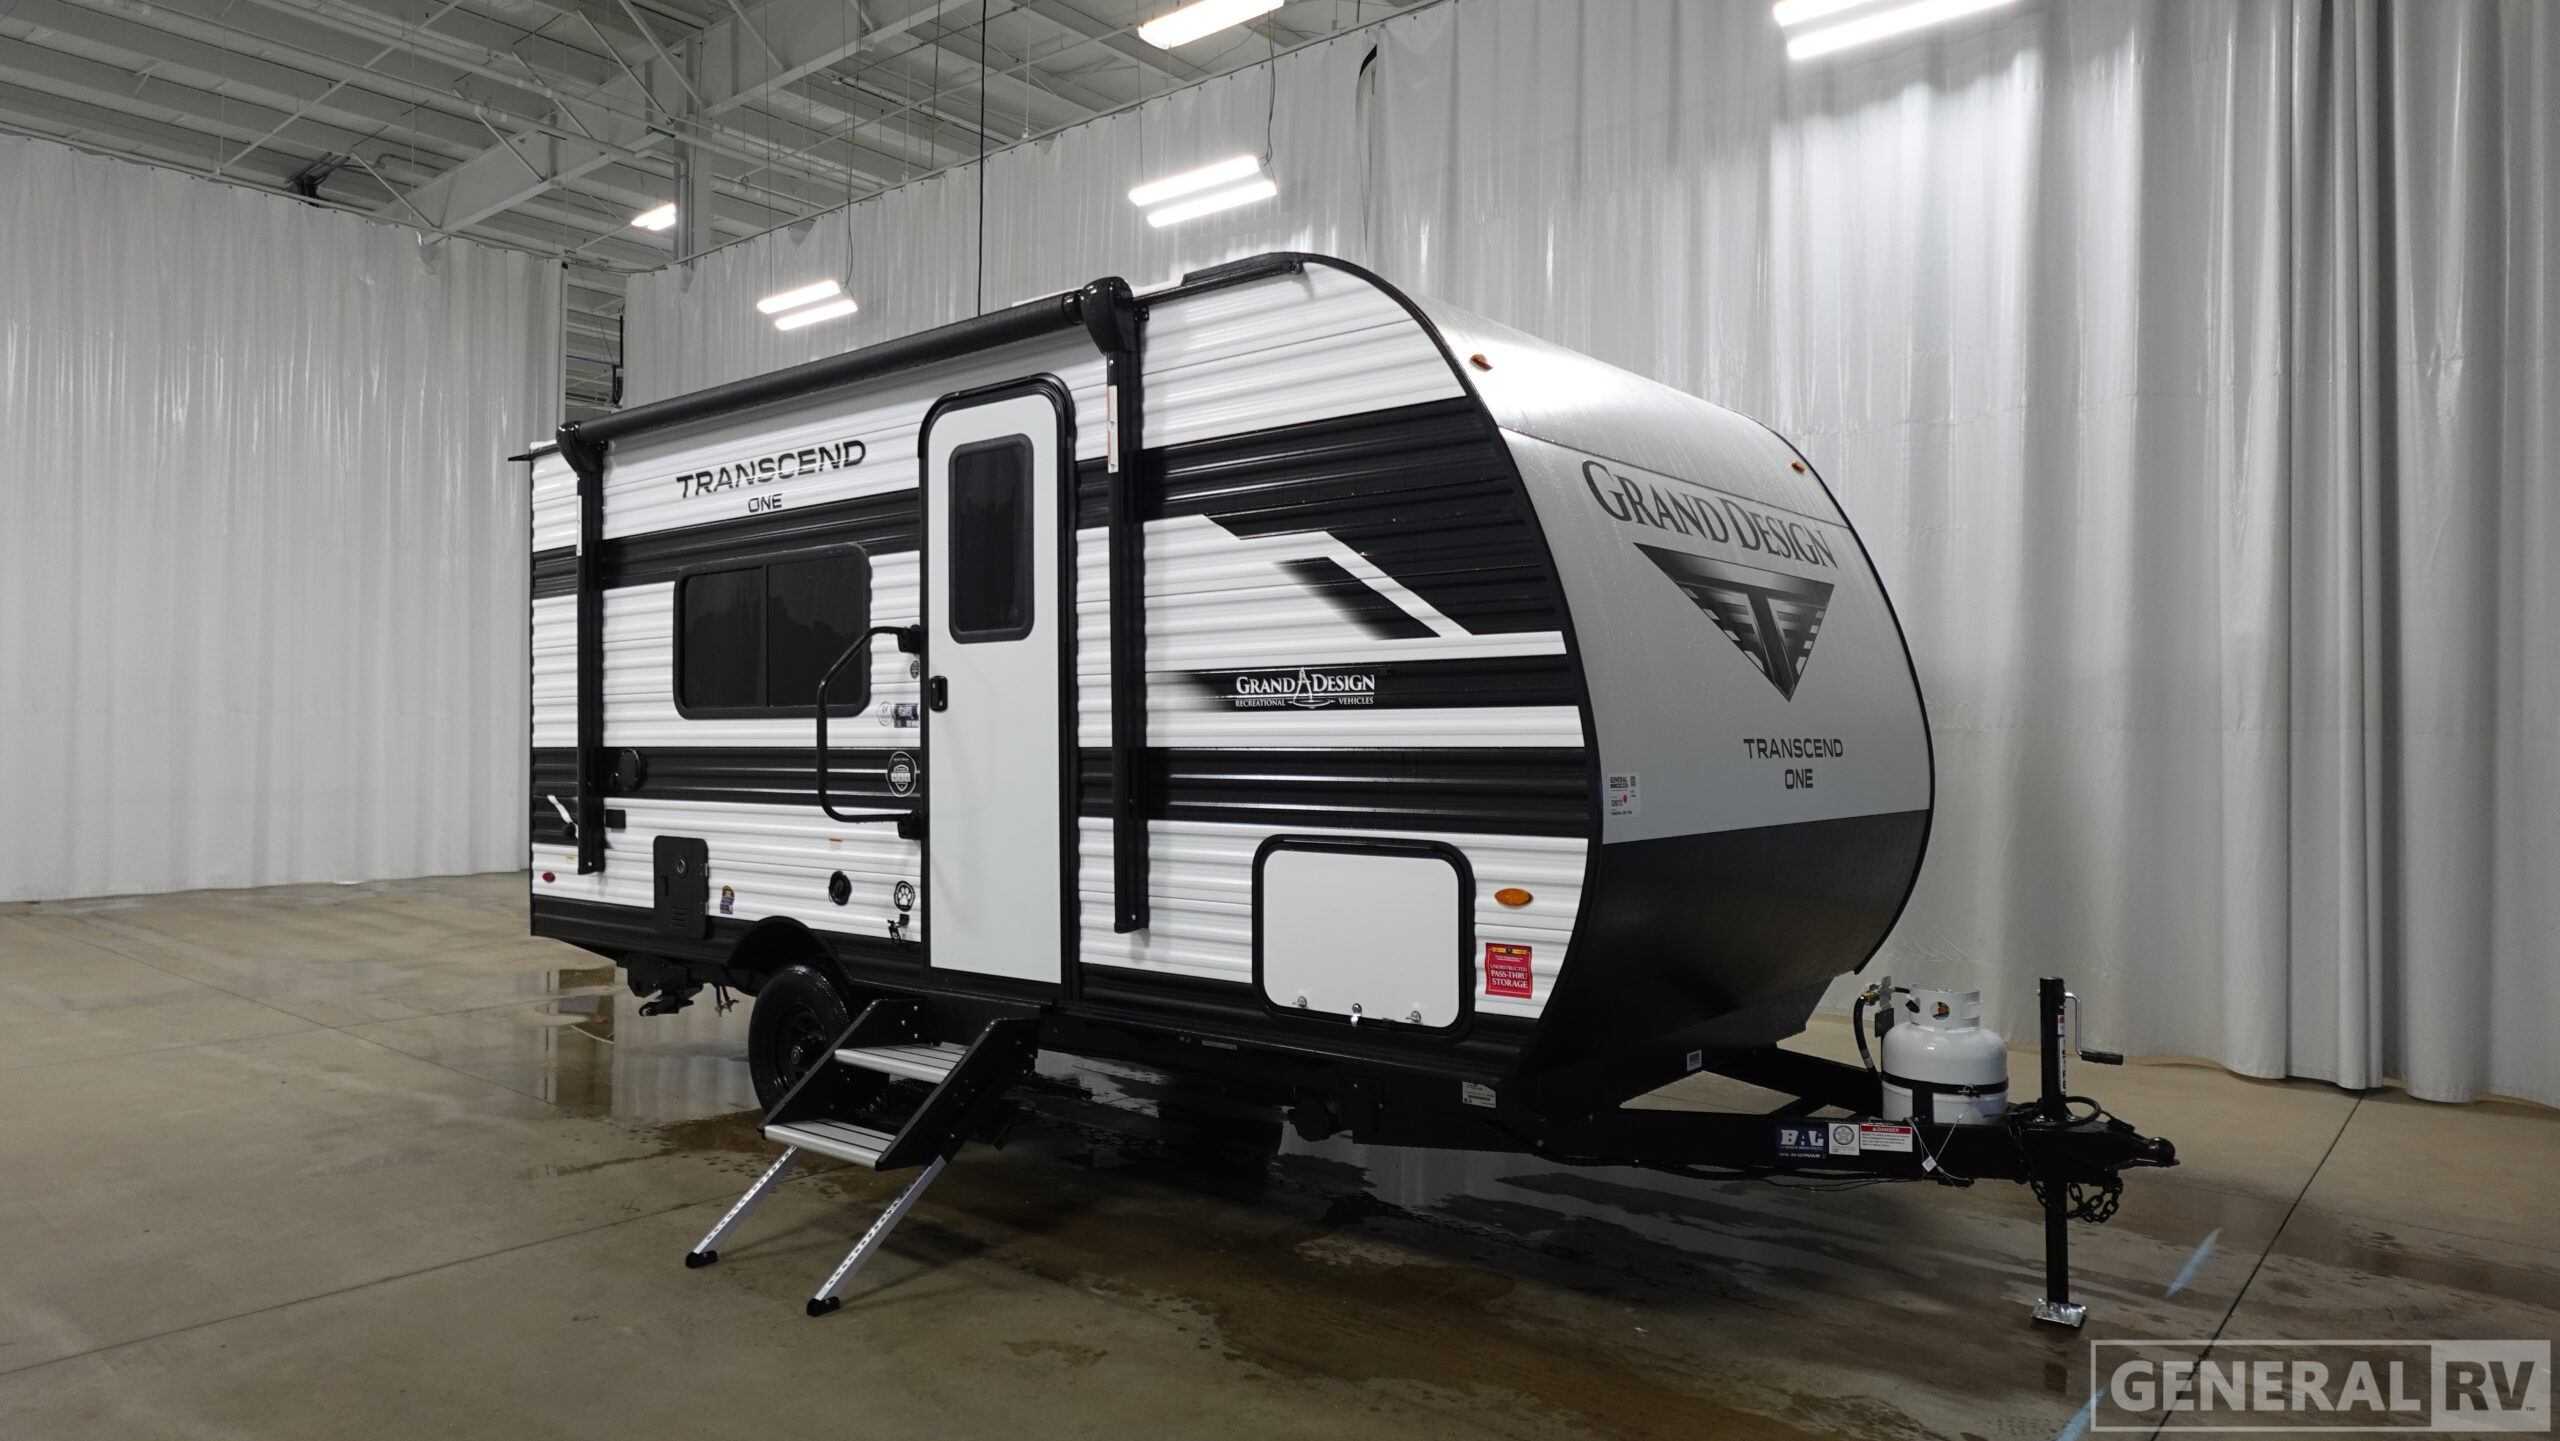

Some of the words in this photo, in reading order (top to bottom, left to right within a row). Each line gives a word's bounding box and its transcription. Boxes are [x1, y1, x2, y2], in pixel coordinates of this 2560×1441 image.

[675, 439, 867, 499] TRANSCEND
[748, 492, 783, 513] ONE
[1581, 459, 1730, 545] GRAND
[1715, 495, 1840, 570] DESIGN
[1235, 675, 1296, 695] GRAND
[1311, 673, 1376, 693] DESIGN
[1235, 699, 1287, 708] RECREATIONAL
[1338, 697, 1375, 705] VEHICLES
[1743, 737, 1844, 760] TRANSCEND
[1784, 768, 1814, 790] ONE
[1491, 969, 1528, 980] PASS-THRU
[1492, 978, 1529, 989] STORAGE
